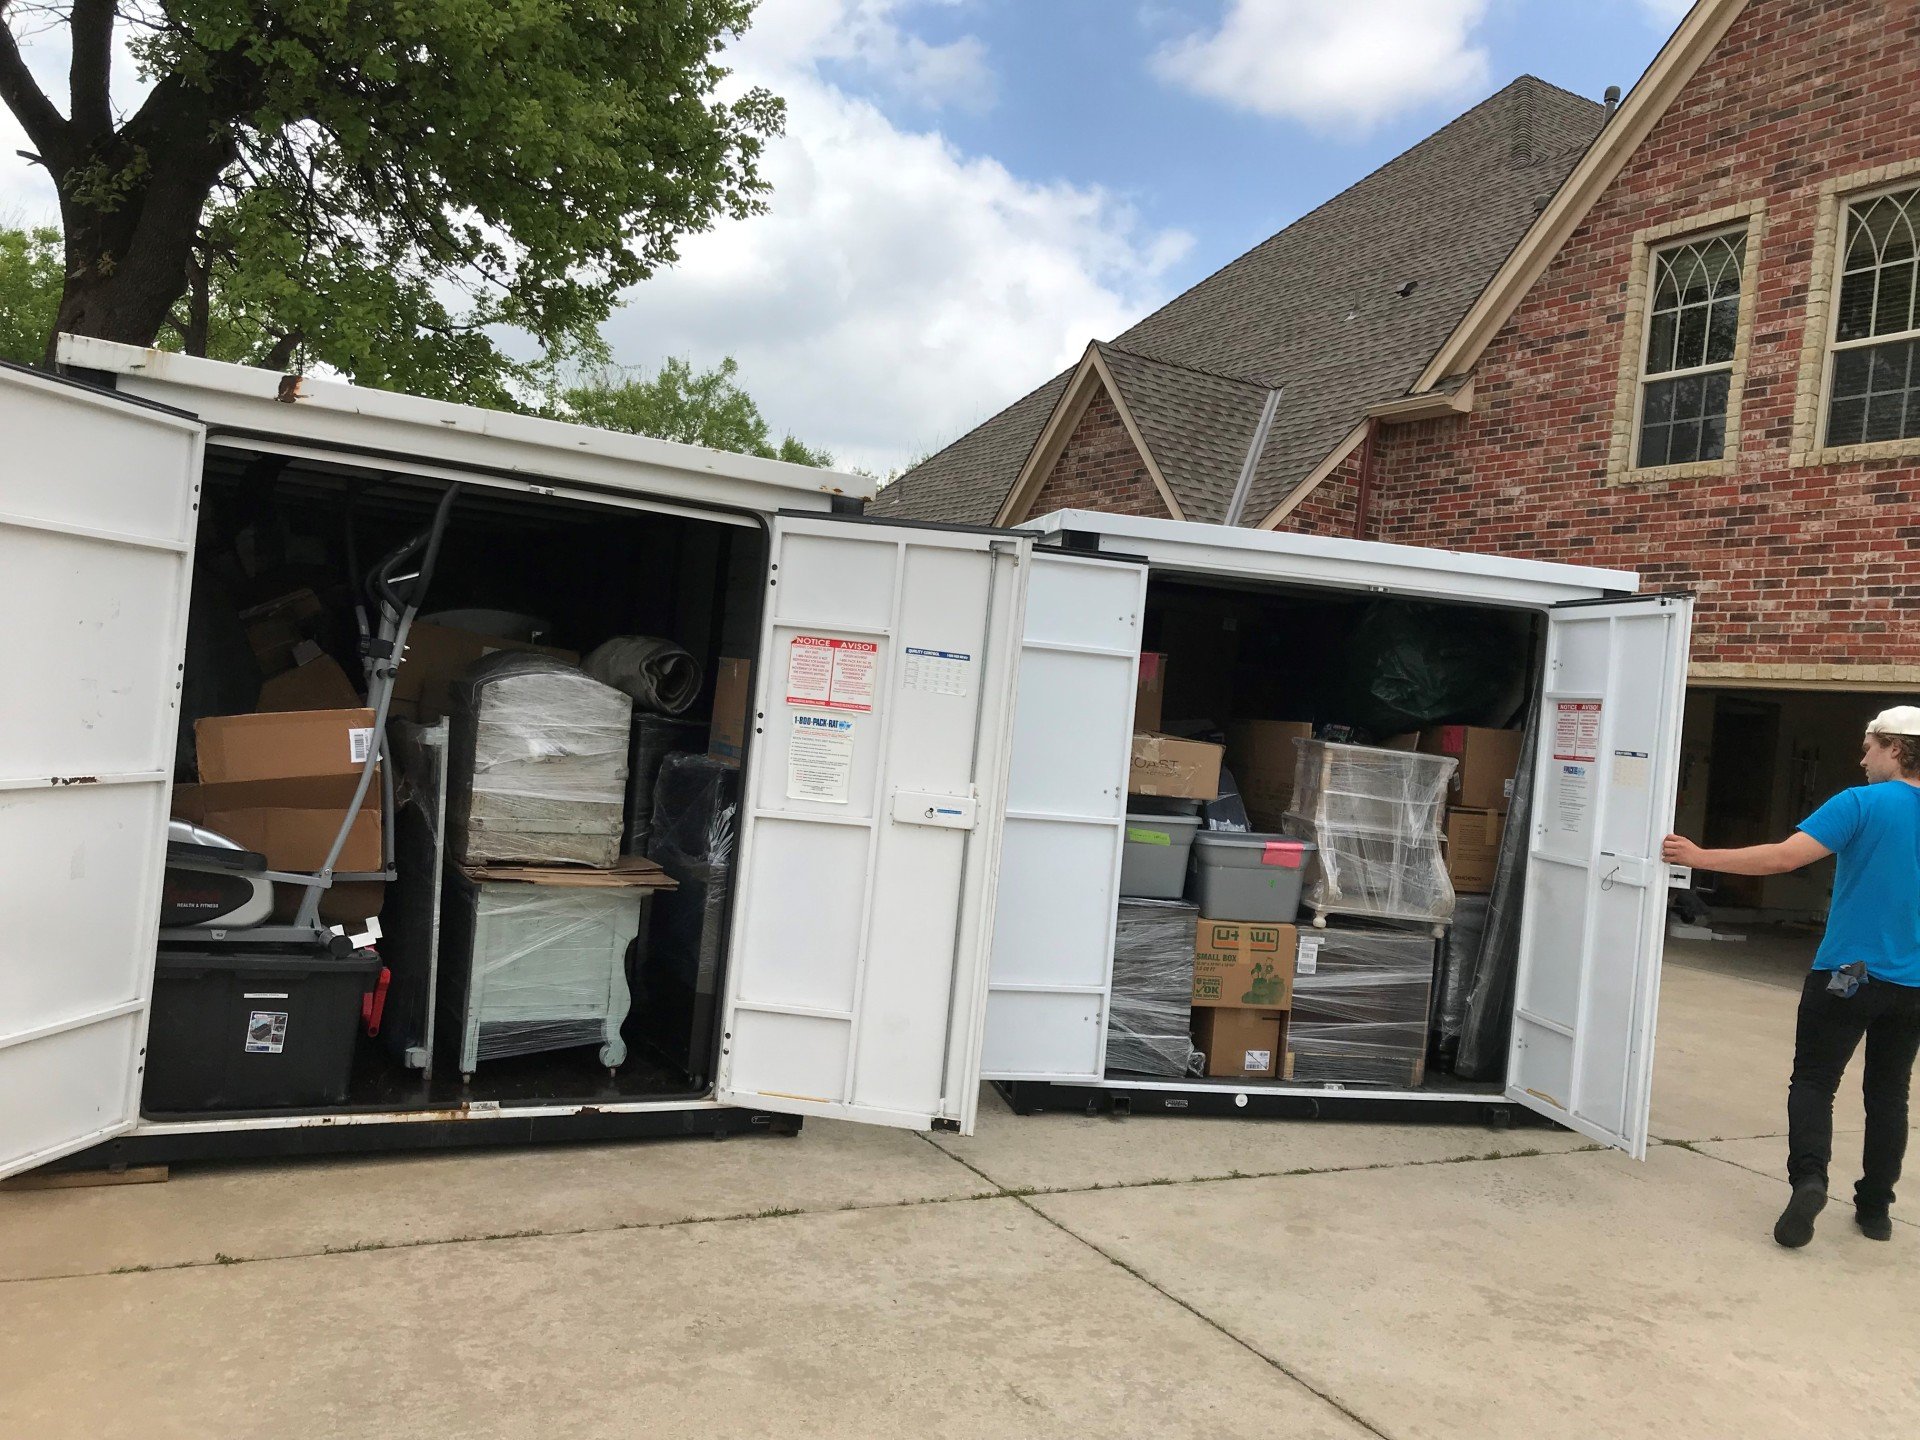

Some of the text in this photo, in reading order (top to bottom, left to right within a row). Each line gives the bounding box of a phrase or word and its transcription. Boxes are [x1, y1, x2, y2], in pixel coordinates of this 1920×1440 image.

[796, 637, 831, 647] NOTICE
[840, 641, 873, 651] AVISO!
[1131, 756, 1179, 770] OAST
[1196, 952, 1237, 962] SMALL BOX
[1203, 985, 1219, 994] OK
